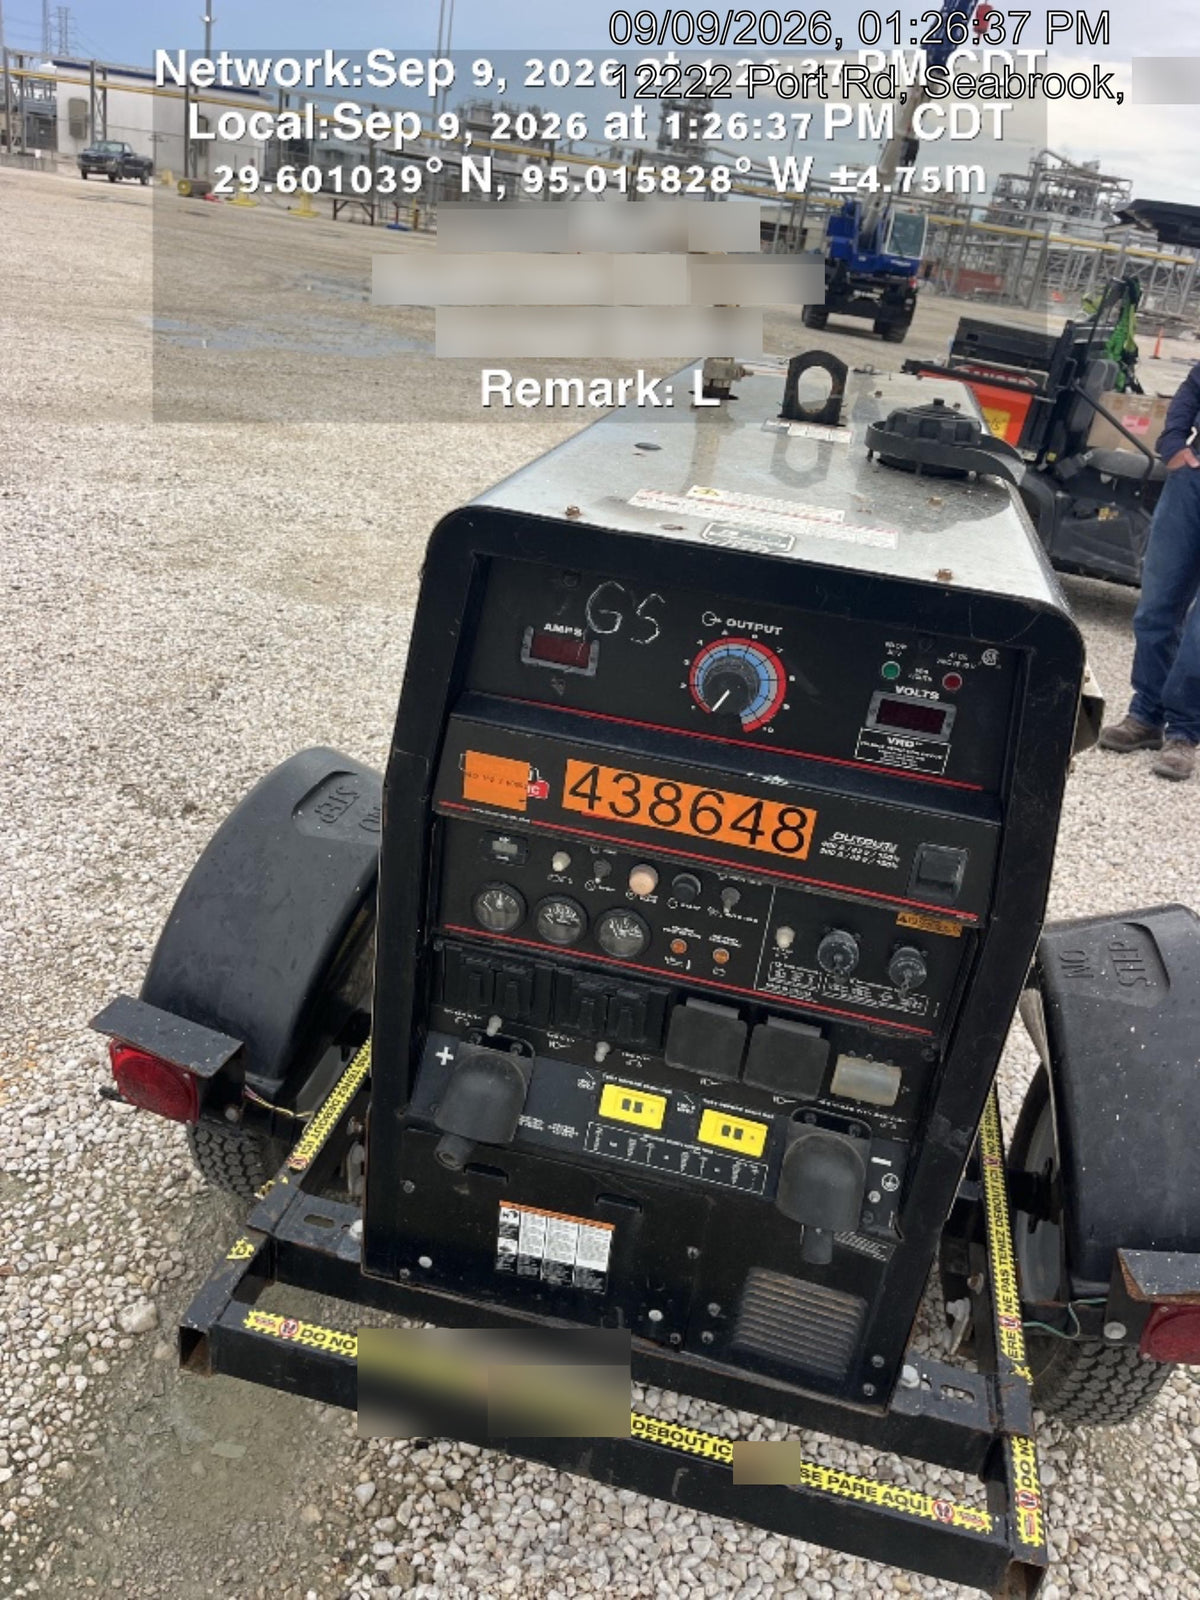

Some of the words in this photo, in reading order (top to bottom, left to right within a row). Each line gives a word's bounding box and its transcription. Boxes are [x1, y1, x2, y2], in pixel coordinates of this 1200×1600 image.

[544, 622, 583, 637] AMPS
[726, 617, 783, 636] OUTPUT
[895, 685, 940, 701] VOLTS
[568, 766, 808, 854] 438648
[1059, 950, 1094, 979] NO
[1107, 941, 1151, 987] STEP
[1001, 1269, 1011, 1293] PAS
[301, 1329, 326, 1342] DO
[632, 1418, 709, 1450] DEBOUT
[801, 1467, 822, 1482] SE
[827, 1475, 877, 1497] PARE
[1020, 1460, 1032, 1488] DO
